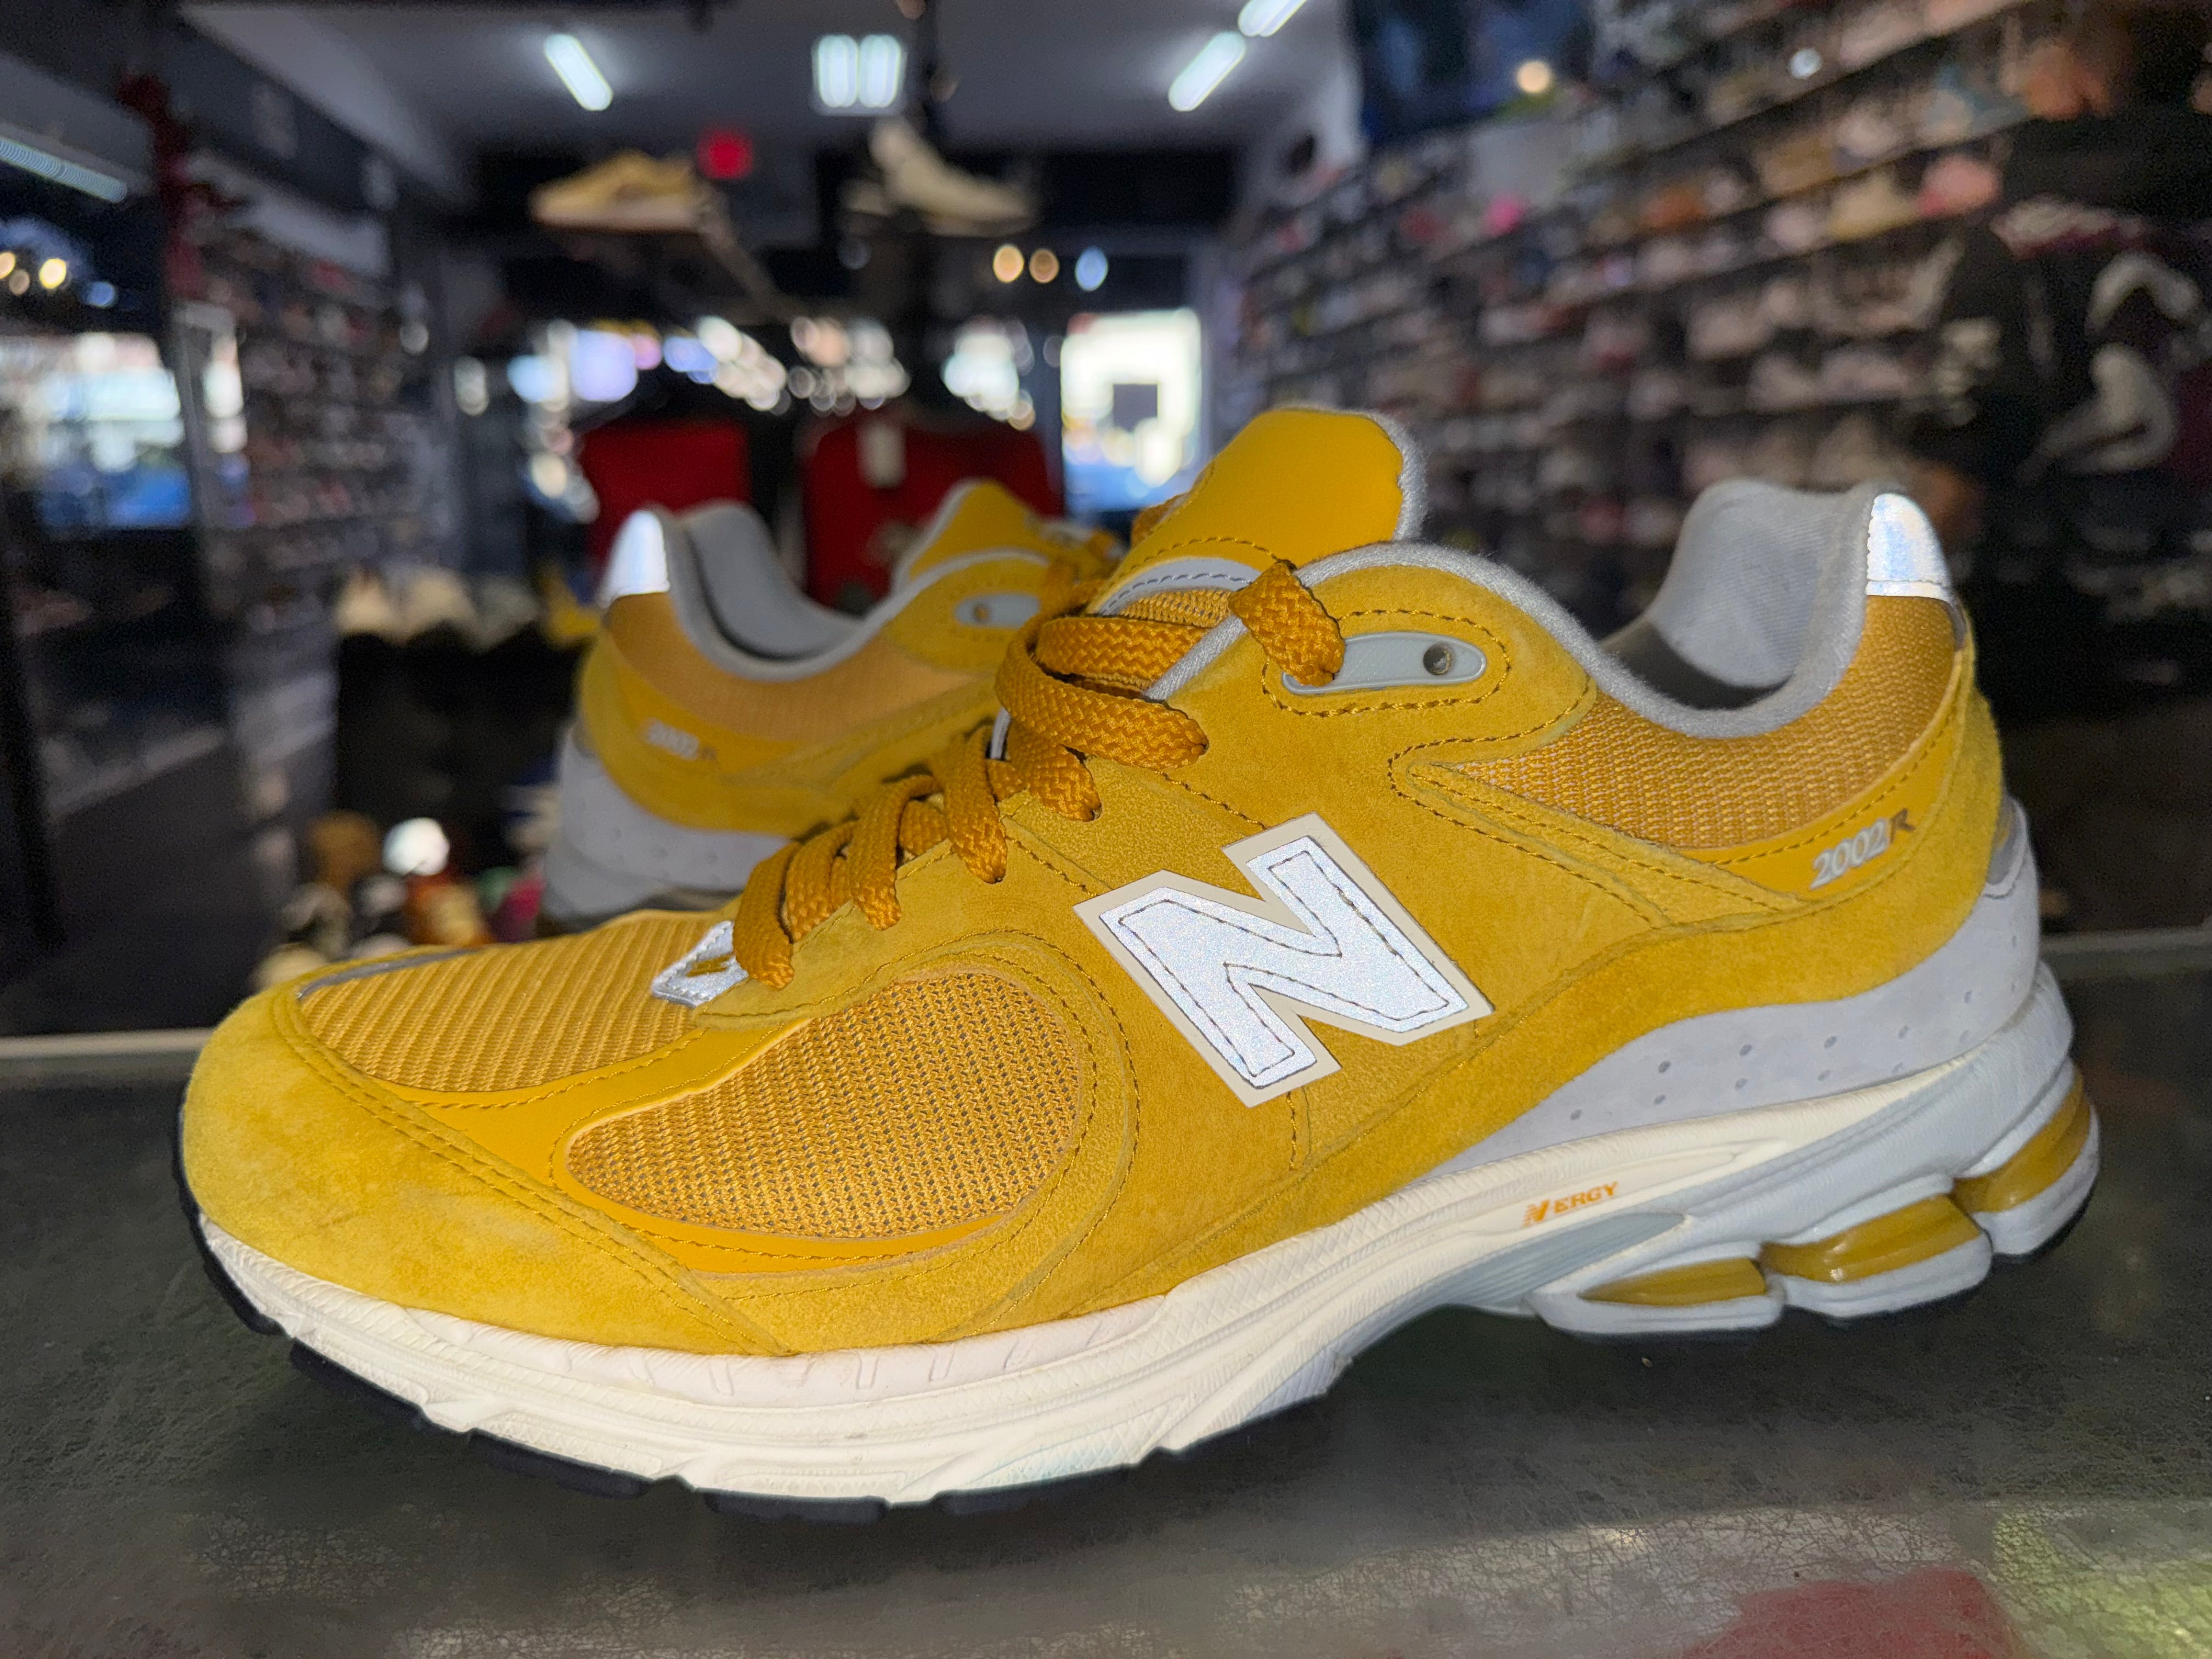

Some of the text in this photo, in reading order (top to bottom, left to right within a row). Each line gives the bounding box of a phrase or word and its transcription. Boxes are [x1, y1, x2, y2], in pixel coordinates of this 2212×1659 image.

[1809, 807, 1916, 890] 2002R
[1073, 812, 1493, 1107] N
[1521, 1181, 1618, 1228] NERGY
